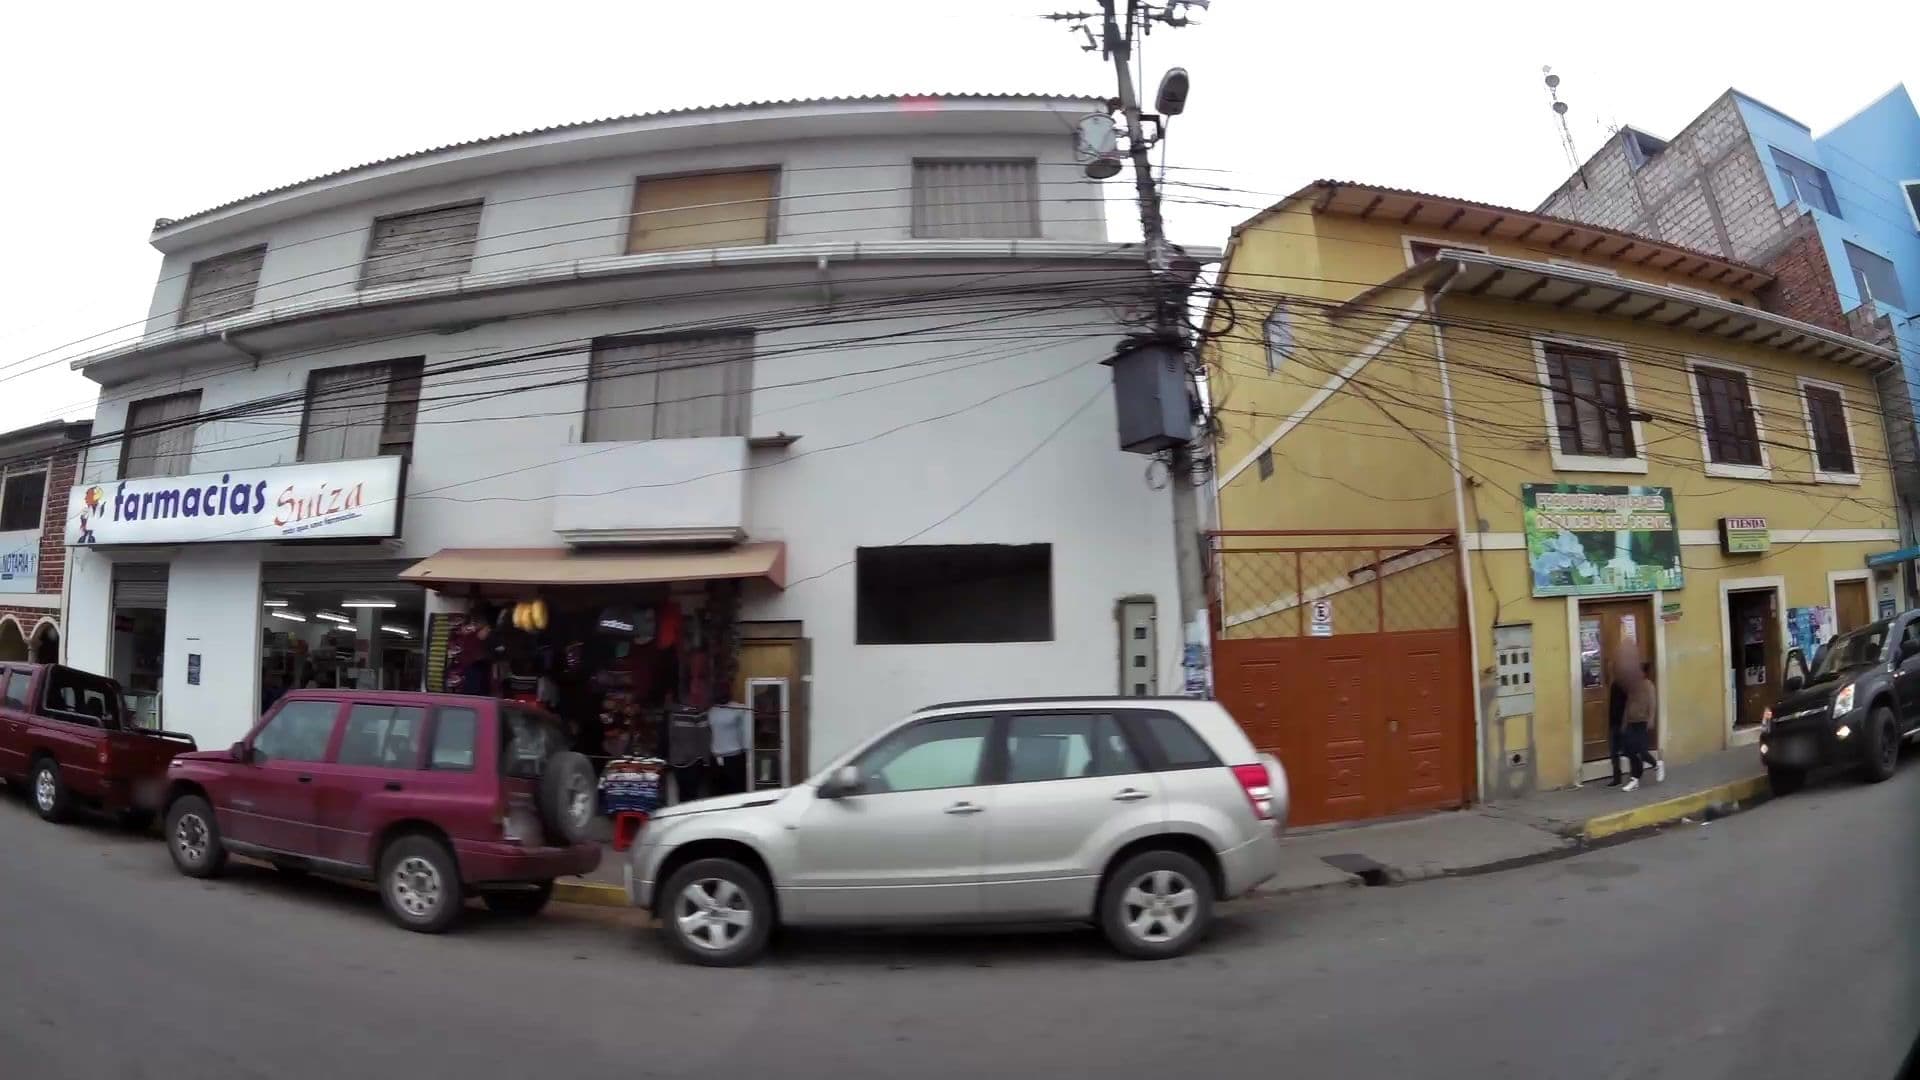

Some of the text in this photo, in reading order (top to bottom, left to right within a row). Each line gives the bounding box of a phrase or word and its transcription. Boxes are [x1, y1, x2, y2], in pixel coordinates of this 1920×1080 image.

[113, 473, 267, 522] farmacias
[274, 481, 366, 526] Suiza
[1728, 519, 1766, 529] TIENDA
[1317, 605, 1325, 617] E
